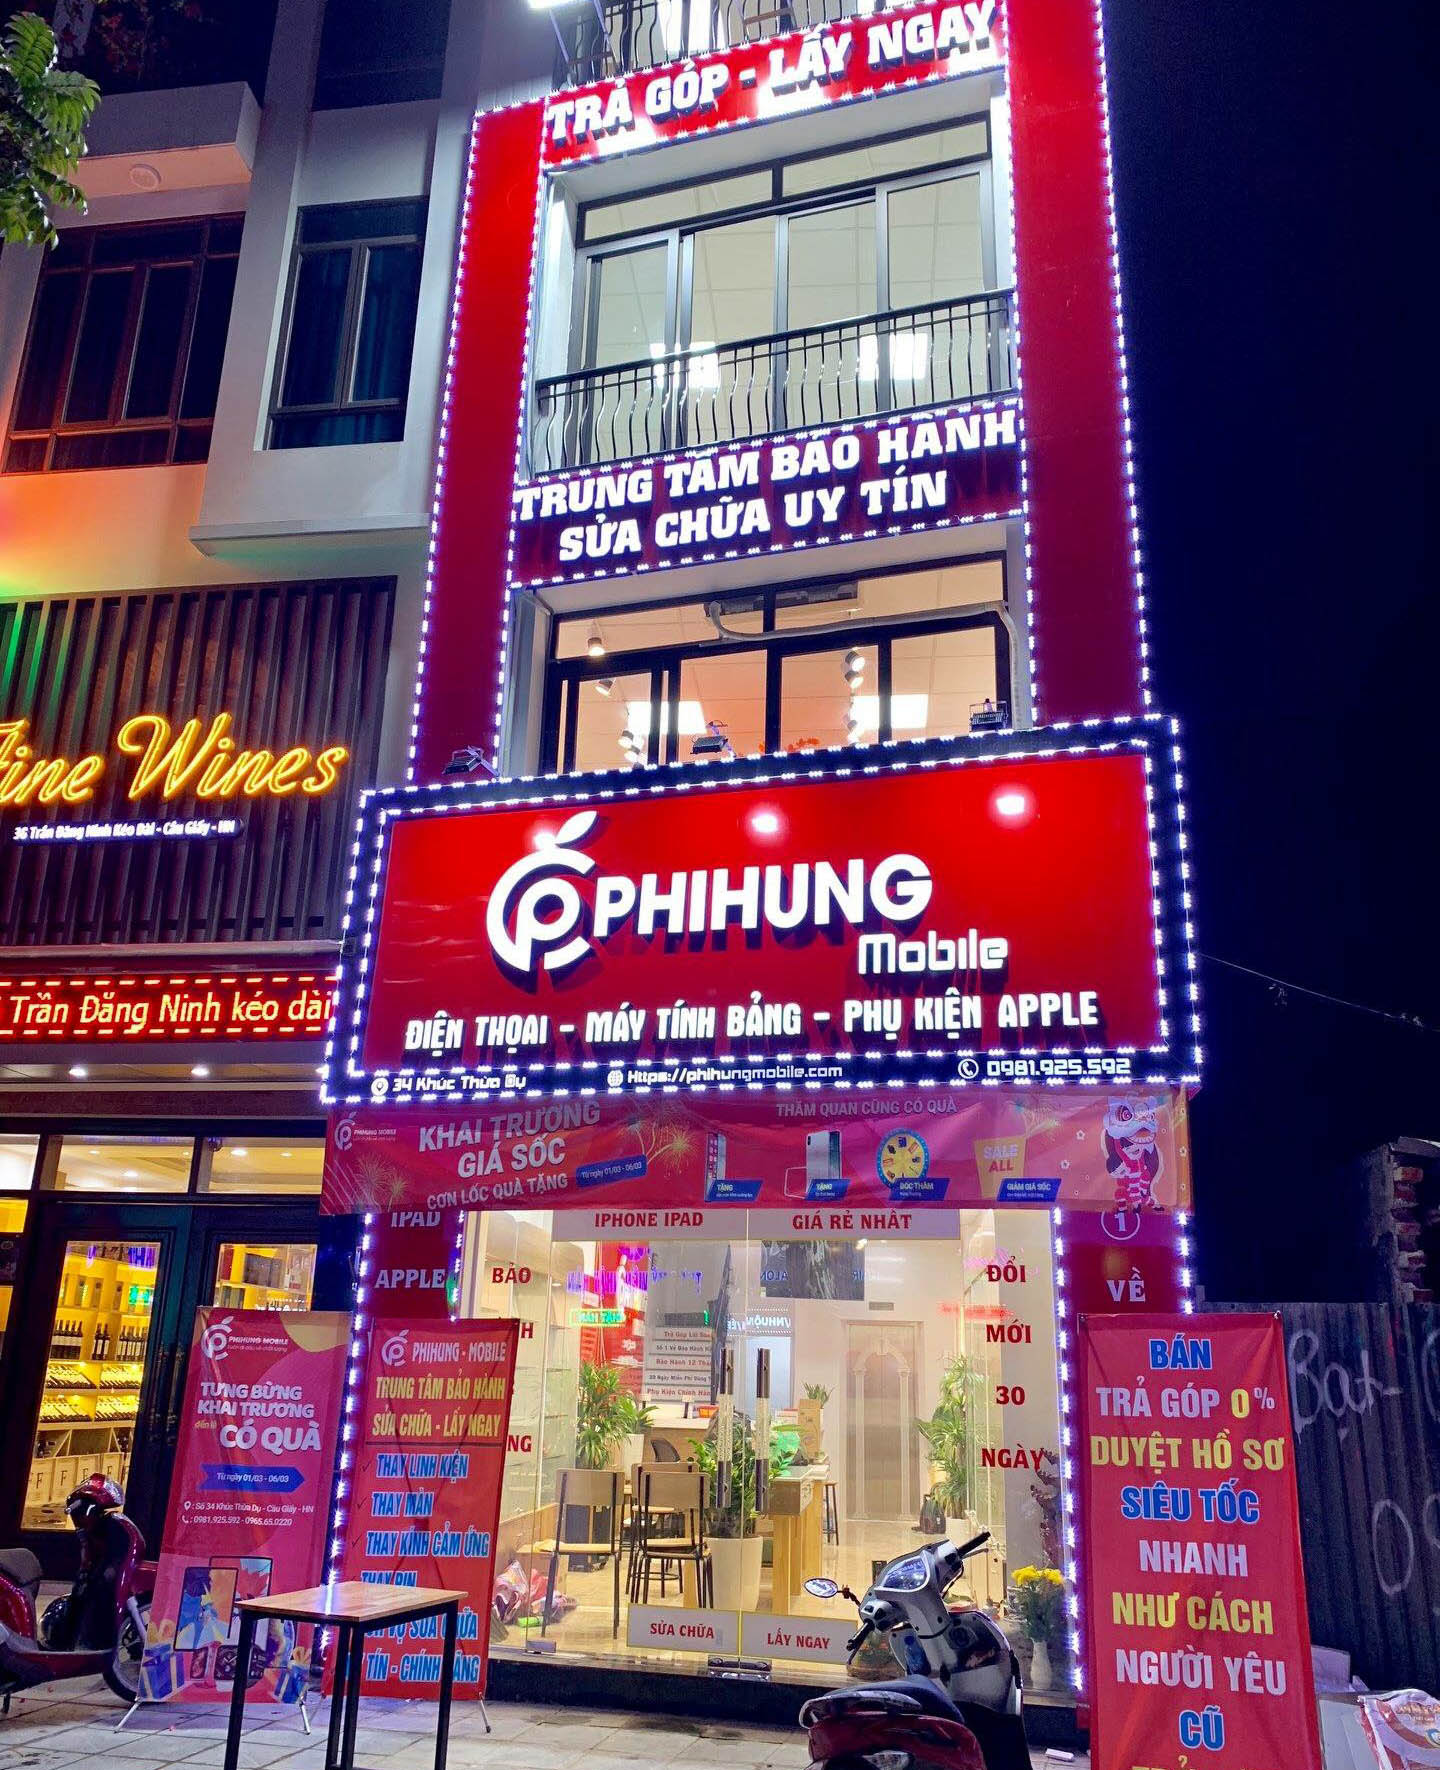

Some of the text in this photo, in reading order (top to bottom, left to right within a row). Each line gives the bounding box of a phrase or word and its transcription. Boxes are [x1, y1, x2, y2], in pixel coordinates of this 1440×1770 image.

[548, 0, 996, 140] TRẢ GÓP LẤY NGAY
[515, 470, 653, 522] TRUNG
[559, 465, 947, 562] SỬA CHỮA UY TÍN
[117, 711, 349, 800] Wines
[593, 853, 933, 939] PHIHUNG
[10, 989, 333, 1033] Trần Đăng Ninh kéo dài
[404, 1009, 464, 1057] ĐIỆN
[585, 1001, 646, 1043] MÁY
[656, 999, 716, 1041] TÍNH
[727, 990, 802, 1037] BẢNG
[843, 998, 902, 1041] PHỤ
[914, 987, 982, 1040] KIỆN
[998, 991, 1098, 1028] APPLE
[392, 1077, 412, 1092] 34
[416, 1076, 456, 1091] Khúc
[460, 1075, 501, 1090] Thừa
[986, 1057, 1131, 1077] 0981.925.592
[820, 1101, 858, 1118] QUAN
[861, 1098, 900, 1116] CŨNG
[903, 1096, 923, 1115] CÓ
[927, 1095, 959, 1116] QUÀ
[418, 1099, 601, 1153] KHAI TRƯƠNG
[457, 1132, 566, 1179] GIÁ SỐC
[988, 1160, 1015, 1173] ALL
[427, 1172, 569, 1211] CƠN LỐC QUÀ TẶNG
[391, 1211, 441, 1228] IPAD
[594, 1211, 704, 1228] IPHONE IPAD
[792, 1210, 912, 1231] GIÁ RẺ NHẤT
[375, 1268, 446, 1290] APPLE
[491, 1262, 533, 1285] BẢO
[985, 1254, 1027, 1283] ĐỔI
[1106, 1266, 1146, 1303] VỀ
[985, 1319, 1032, 1344] MỚI
[467, 1341, 507, 1363] MOBILE
[1148, 1332, 1213, 1371] BÁN
[200, 1380, 303, 1401] TƯNG BỪNG
[375, 1367, 507, 1401] TRUNG TÂM BẢO HÀNH
[995, 1385, 1026, 1406] 30
[1095, 1374, 1152, 1419] TRẢ
[1160, 1382, 1220, 1419] GÓP
[197, 1399, 315, 1419] KHAI TRƯƠNG
[372, 1403, 502, 1438] SỬA CHỮA LẤY NGAY
[219, 1417, 322, 1456] CÓ QUÀ
[1089, 1427, 1285, 1475] DUYỆT HỒ SƠ
[375, 1448, 470, 1484] THAY LINH KIỆN
[980, 1446, 1046, 1472] NGÀY
[302, 1505, 314, 1514] HN
[371, 1491, 404, 1518] THAY
[1120, 1477, 1260, 1525] SIÊU TỐC
[365, 1520, 491, 1558] THAY KÍNH CẢM ỨNG
[1138, 1539, 1249, 1578] NHANH
[649, 1620, 715, 1640] SỬA CHỮA
[1112, 1590, 1274, 1635] NHƯ CÁCH
[767, 1627, 831, 1650] LẤY NGAY
[365, 1647, 391, 1682] TÍN
[1115, 1644, 1288, 1697] NGƯỜI YÊU
[1177, 1704, 1226, 1752] CŨ
